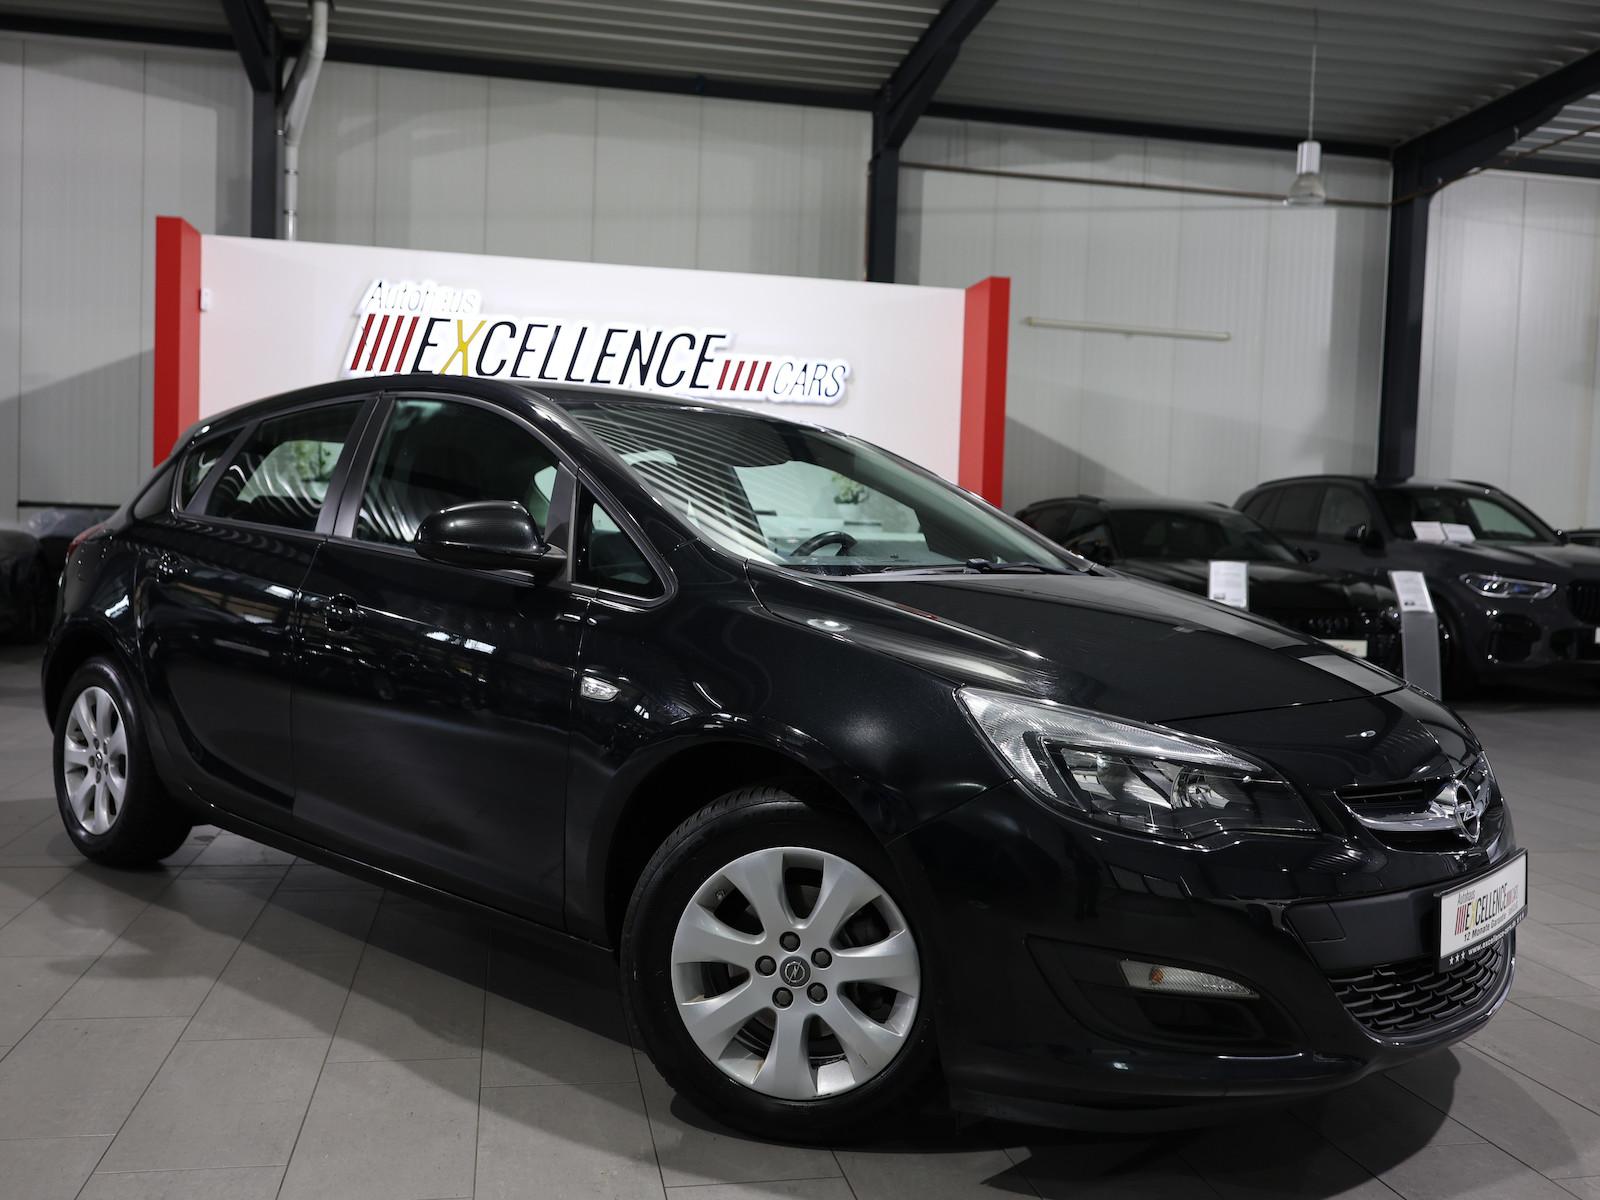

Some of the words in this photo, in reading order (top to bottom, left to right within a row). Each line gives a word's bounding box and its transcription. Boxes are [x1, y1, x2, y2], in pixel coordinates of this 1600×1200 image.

[411, 317, 727, 390] EXCELLENCE
[773, 361, 846, 397] CARS
[1465, 882, 1508, 931] EXCELLENCE
[1464, 931, 1471, 942] 12
